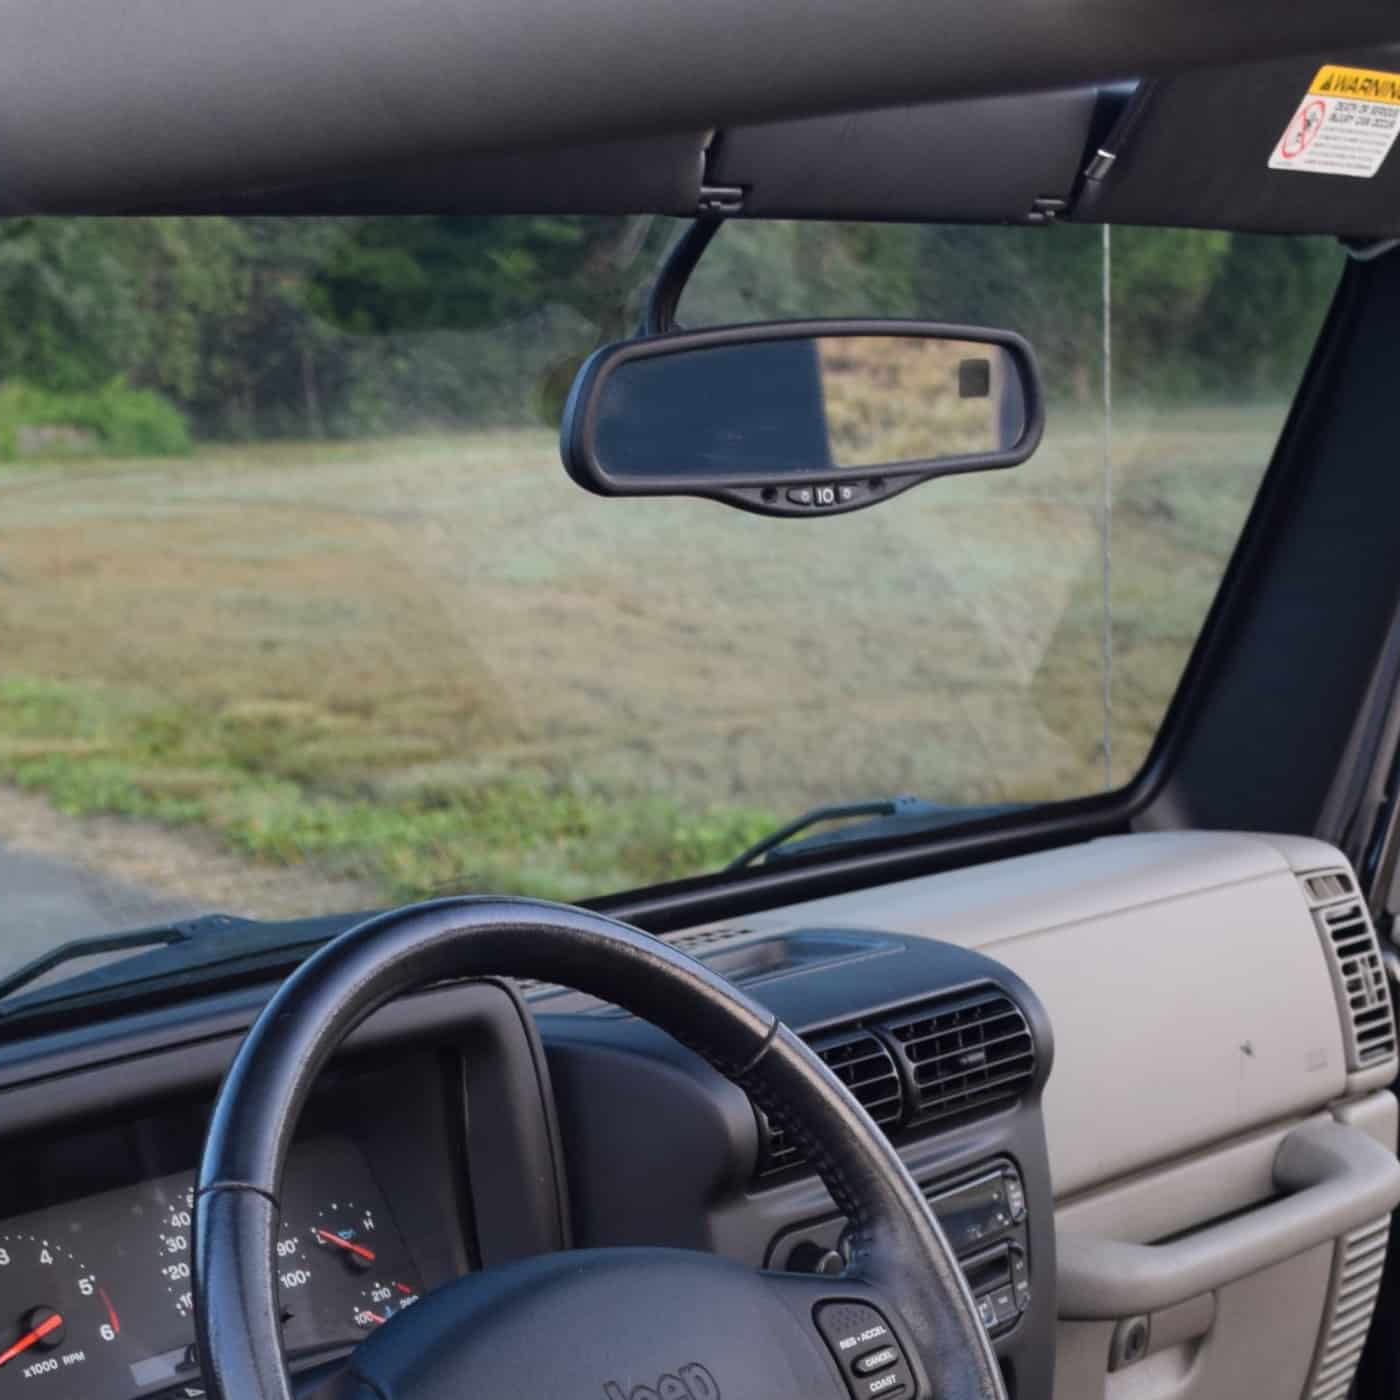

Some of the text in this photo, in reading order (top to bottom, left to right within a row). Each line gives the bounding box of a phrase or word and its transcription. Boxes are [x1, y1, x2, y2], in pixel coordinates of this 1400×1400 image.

[171, 1211, 191, 1228] 40
[165, 1235, 187, 1253] 30
[276, 1239, 296, 1257] 90
[40, 1250, 54, 1265] 4
[168, 1262, 190, 1281] 20
[280, 1270, 307, 1288] 100
[78, 1278, 93, 1296] 5
[371, 1287, 392, 1303] 210
[99, 1324, 115, 1341] 6
[24, 1351, 86, 1378] x1000 RPM
[870, 1374, 897, 1392] COAST
